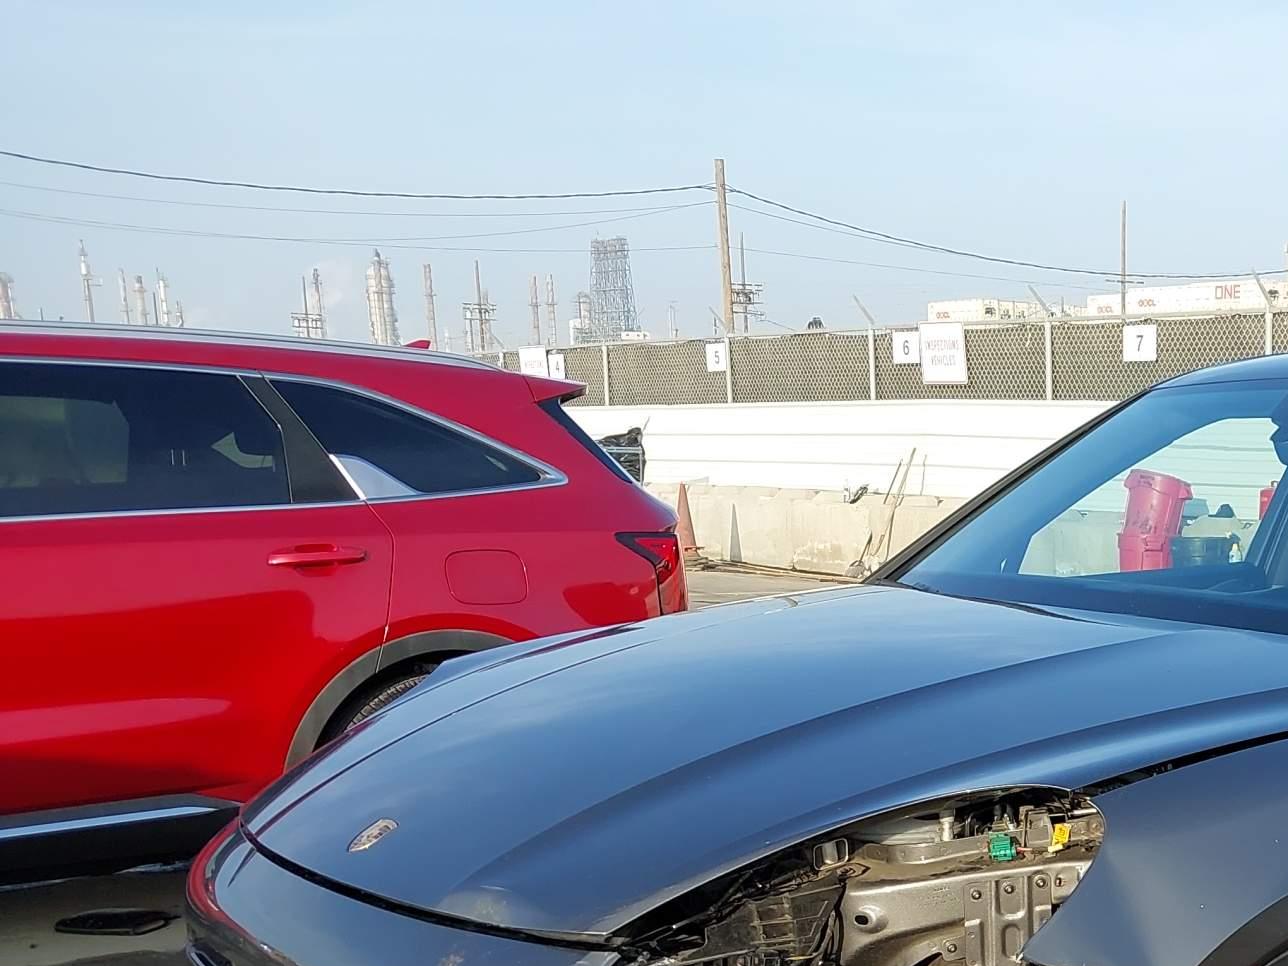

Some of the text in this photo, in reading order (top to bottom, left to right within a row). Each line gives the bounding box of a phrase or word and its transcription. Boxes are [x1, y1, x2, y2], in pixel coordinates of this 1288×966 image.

[1215, 284, 1241, 300] ONE
[902, 340, 910, 356] 6
[1136, 335, 1144, 353] 7
[714, 351, 720, 365] 5
[555, 360, 560, 373] 4
